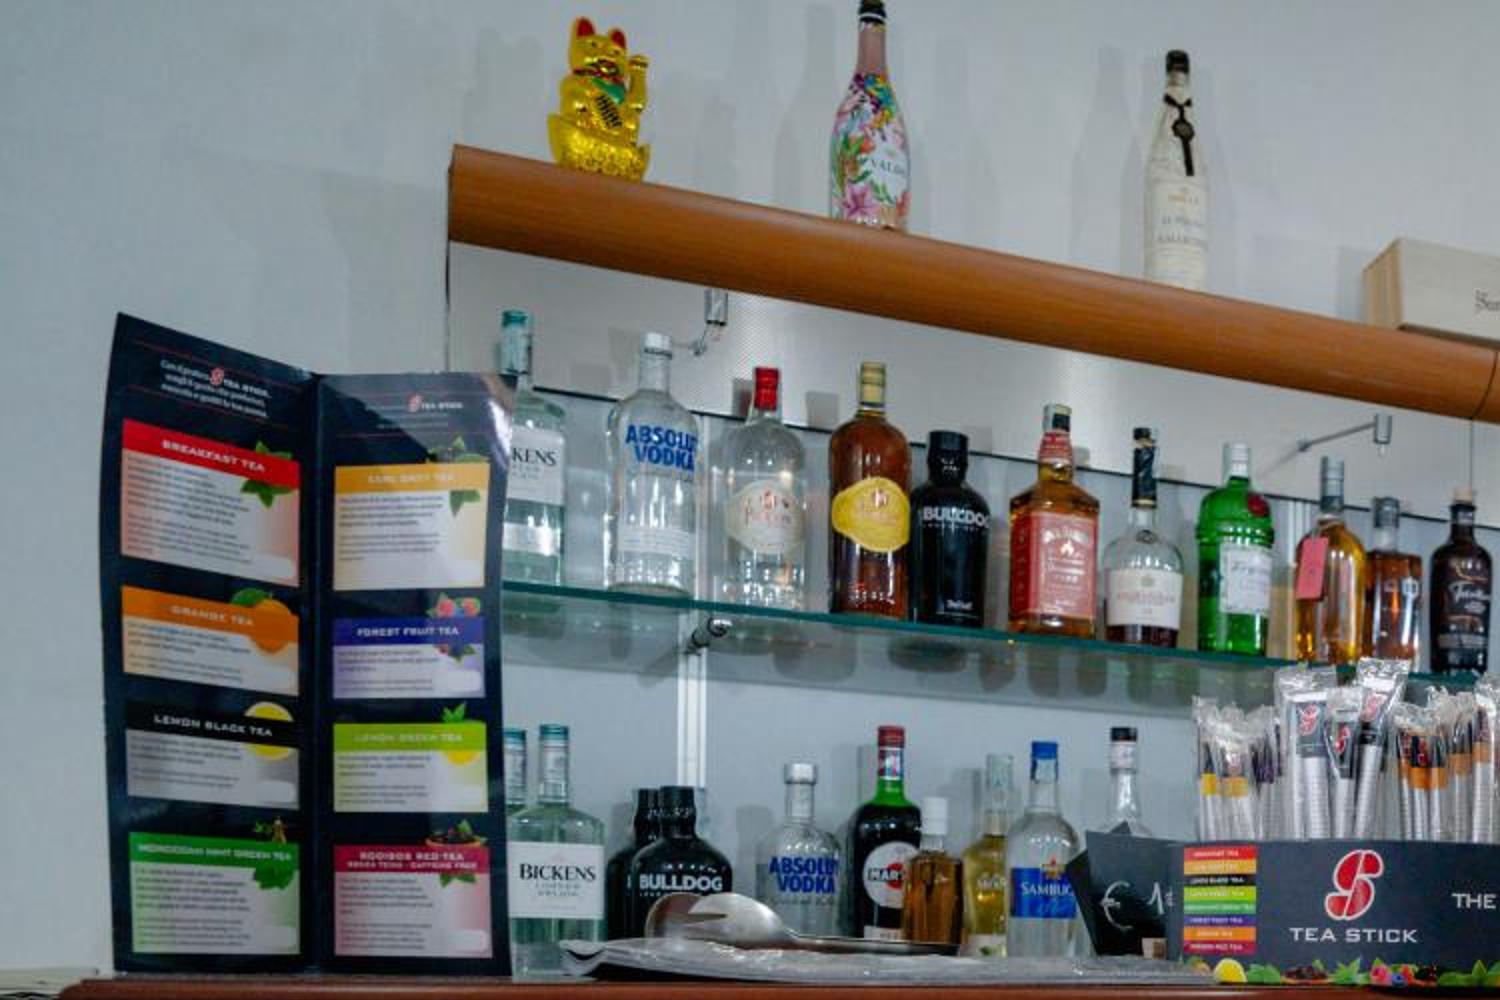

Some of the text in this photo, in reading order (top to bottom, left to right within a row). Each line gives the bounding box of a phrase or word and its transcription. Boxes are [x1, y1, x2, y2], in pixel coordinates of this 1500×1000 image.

[162, 439, 266, 472] BREAKFAST TEA
[634, 445, 695, 472] VODKA
[356, 625, 460, 638] FOREST FRUIT TEA
[153, 714, 274, 738] LEMON BLACK TEA
[442, 851, 465, 861] TEA
[518, 863, 597, 881] BICKENS
[639, 873, 723, 891] BULLDOG
[777, 874, 837, 894] VODKA
[1451, 892, 1497, 910] THE
[1290, 927, 1418, 944] TEA STICK
